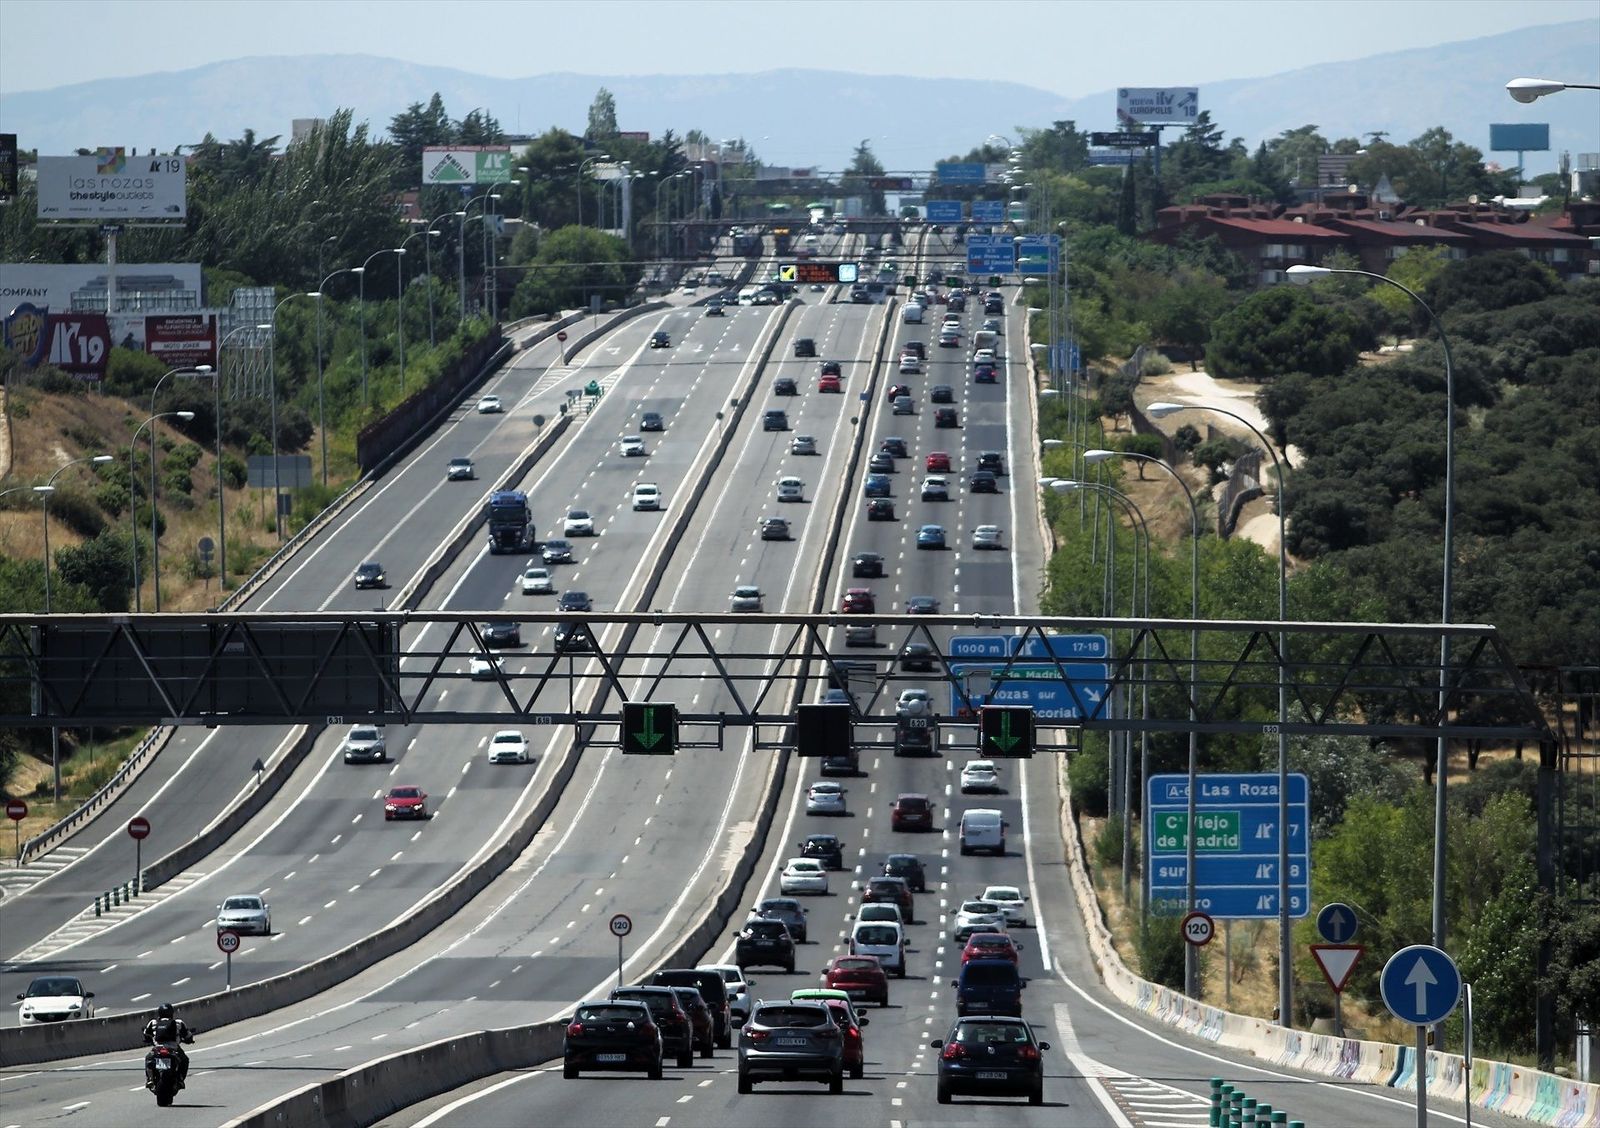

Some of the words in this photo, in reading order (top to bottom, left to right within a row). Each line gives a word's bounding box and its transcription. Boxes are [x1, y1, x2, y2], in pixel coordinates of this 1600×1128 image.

[1129, 106, 1173, 115] EUROPOLIS
[165, 160, 180, 173] 19
[69, 175, 96, 189] las
[101, 177, 154, 189] rozas
[78, 335, 104, 364] 19
[958, 644, 985, 653] 1000
[989, 645, 1000, 653] m
[1072, 642, 1099, 652] 17-18
[1038, 691, 1056, 700] sur
[1032, 706, 1077, 719] scorial
[1202, 784, 1230, 797] Las
[1240, 783, 1281, 796] Roza
[1157, 834, 1177, 848] de
[1159, 866, 1186, 878] sur
[1160, 898, 1212, 909] cenro
[615, 921, 628, 930] 120
[1187, 923, 1209, 935] 120
[221, 937, 237, 946] 120
